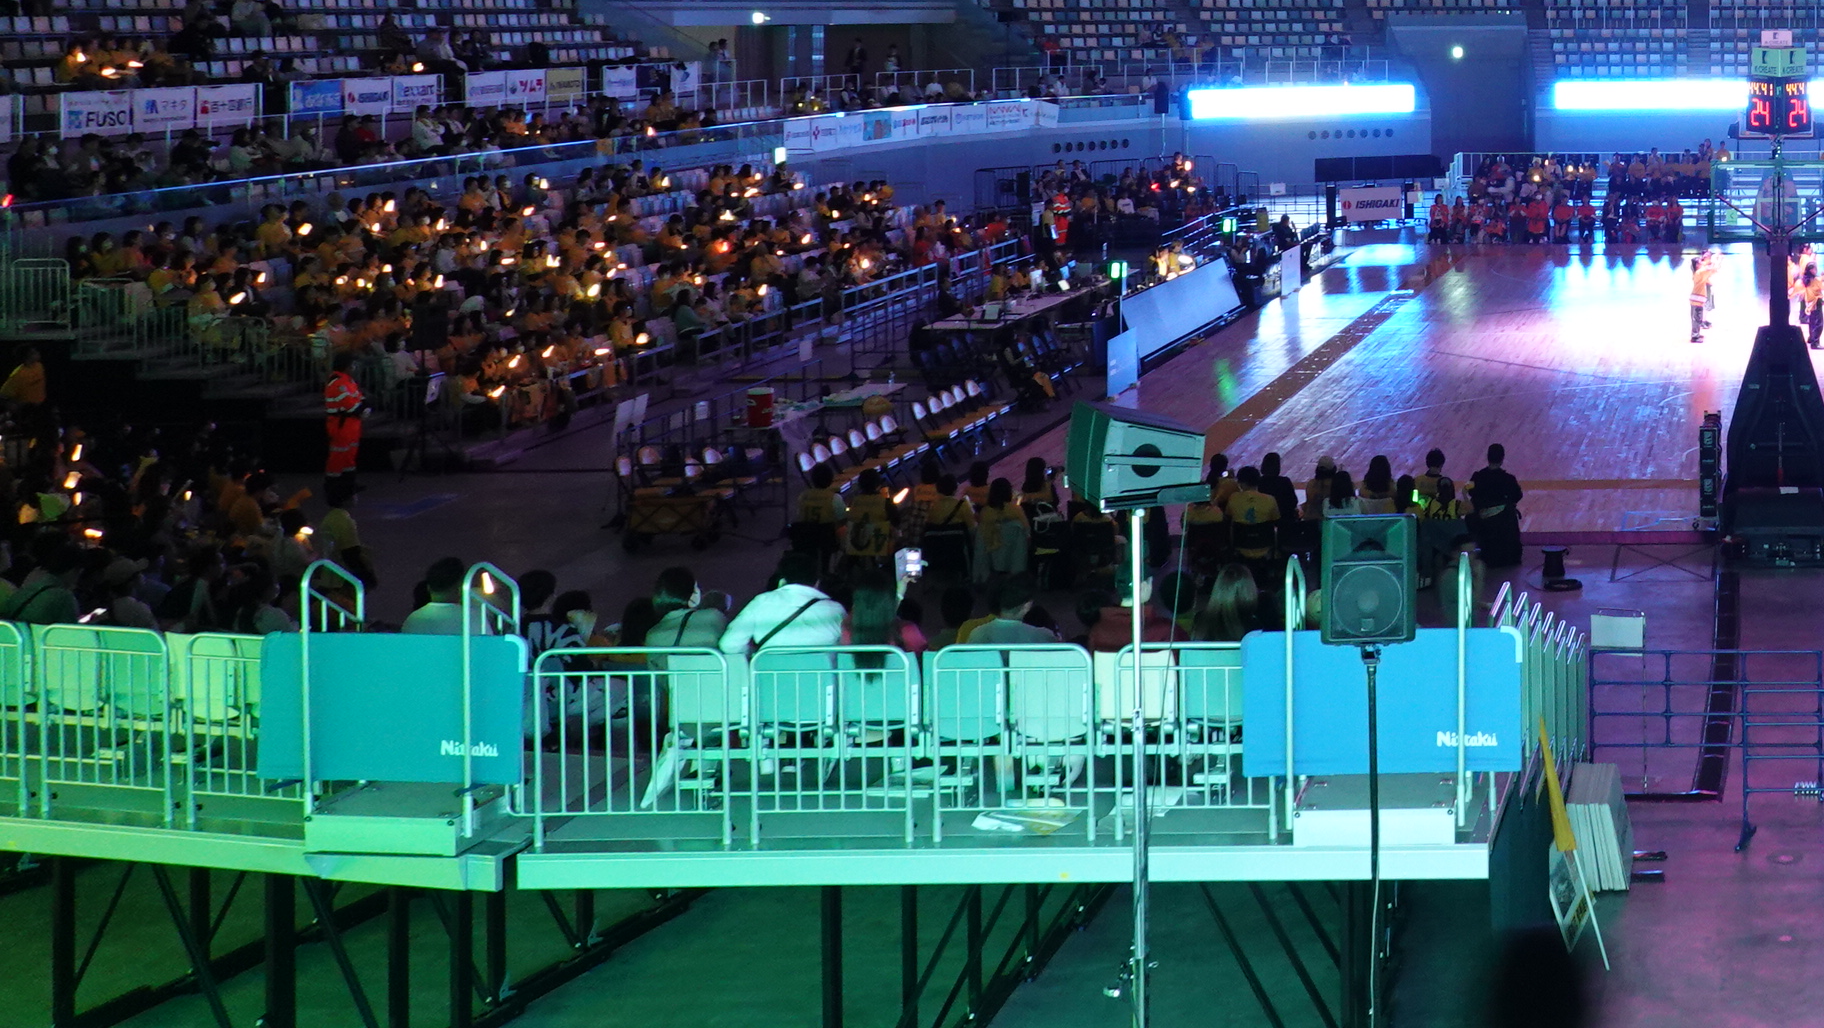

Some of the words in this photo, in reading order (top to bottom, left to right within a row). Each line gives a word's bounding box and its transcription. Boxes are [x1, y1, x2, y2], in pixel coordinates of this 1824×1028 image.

[161, 99, 188, 112] マキタ
[1750, 97, 1770, 127] 24
[1788, 98, 1807, 128] 24
[1355, 198, 1401, 210] ISHIGAKI
